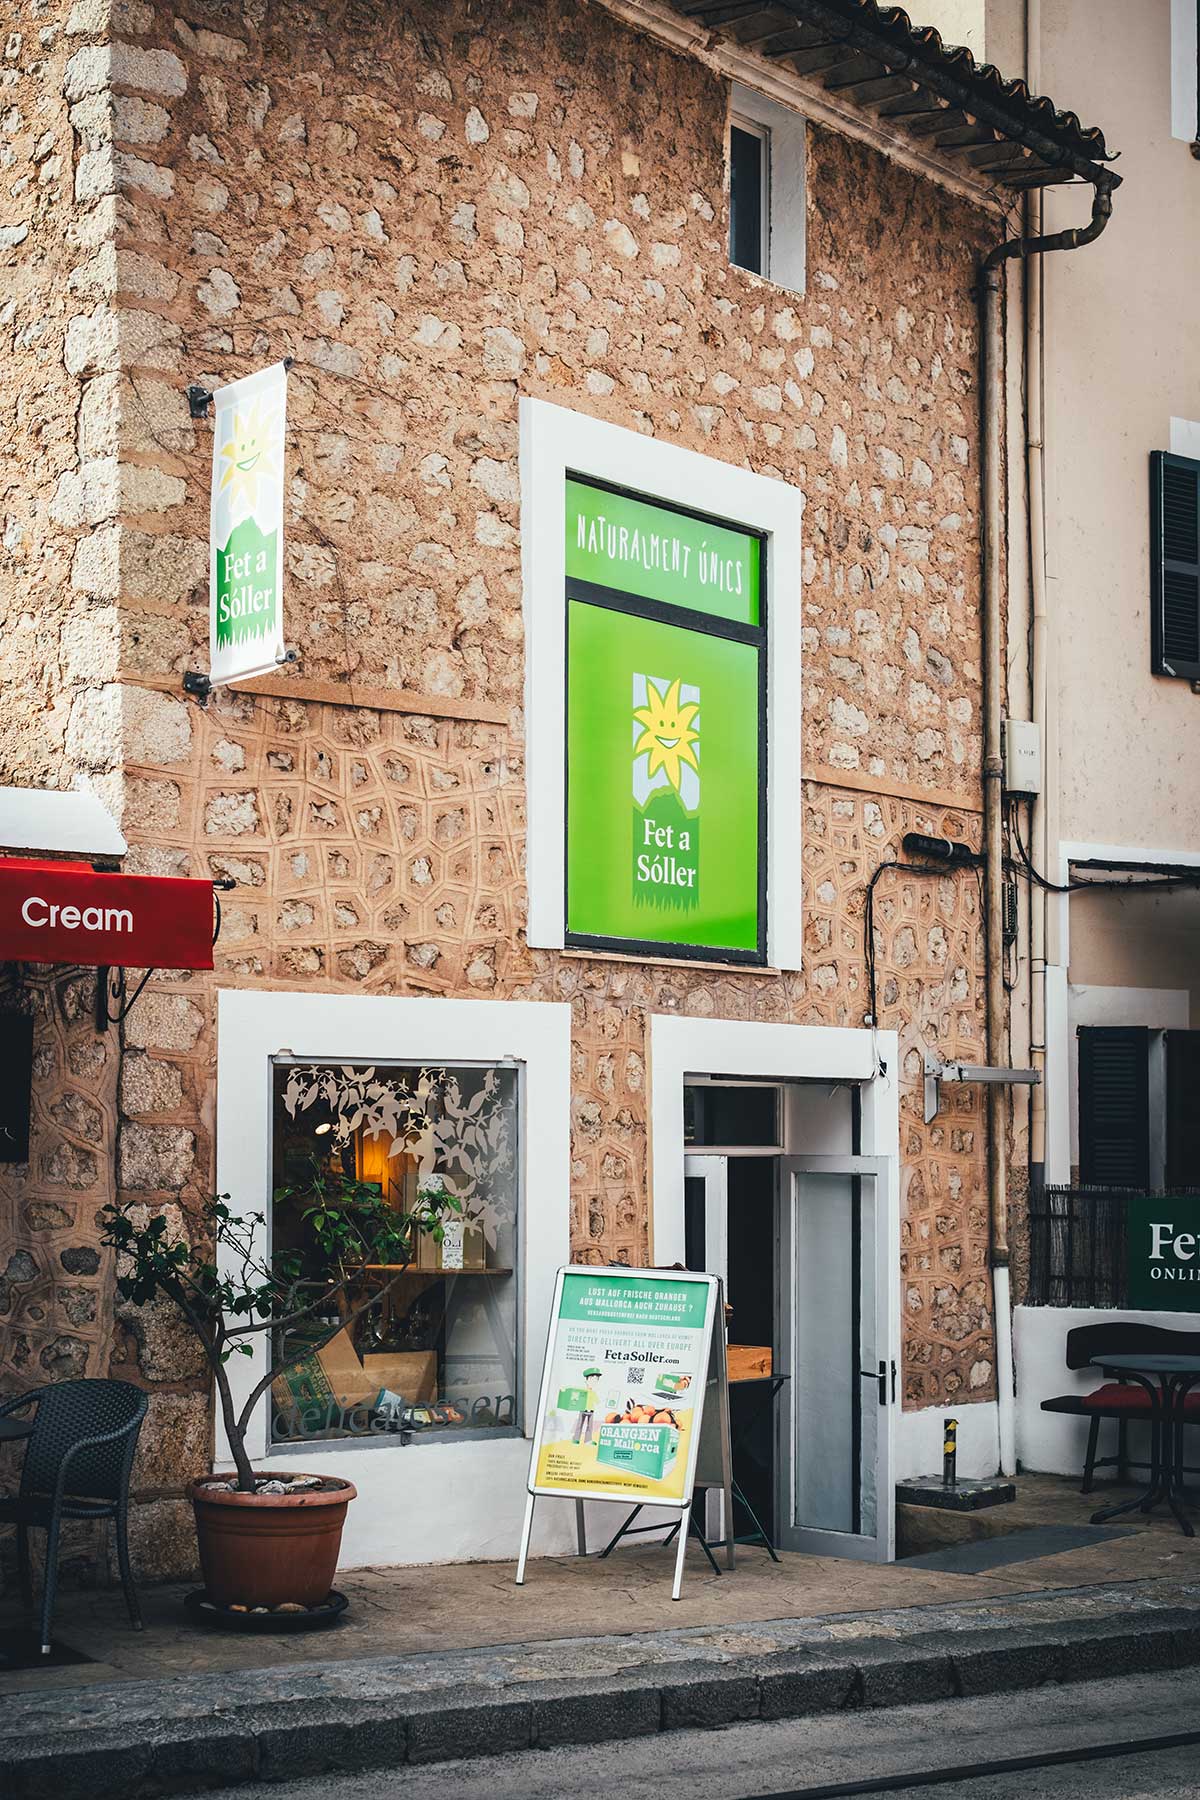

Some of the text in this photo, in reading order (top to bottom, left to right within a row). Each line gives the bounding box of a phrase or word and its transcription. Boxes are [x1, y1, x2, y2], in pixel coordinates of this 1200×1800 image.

[224, 550, 267, 583] Fet a
[577, 513, 743, 595] NATURALMENT ÚNICS
[219, 584, 272, 623] Sóller
[643, 818, 691, 851] Fet a
[637, 853, 697, 888] Sóller
[21, 896, 133, 933] Cream
[1148, 1223, 1200, 1261] Fe
[1150, 1266, 1200, 1281] ONLI
[579, 1297, 593, 1306] AUS
[595, 1298, 632, 1309] MALLORCA
[634, 1301, 653, 1311] AUCH
[654, 1302, 687, 1312] ZUHAUSE
[588, 1287, 606, 1297] LUST
[607, 1288, 622, 1298] AUF
[623, 1289, 653, 1300] FRISCHE
[568, 1335, 598, 1345] DIRECTLY
[272, 1393, 516, 1439] delicatessen
[600, 1426, 662, 1442] ORANGEN
